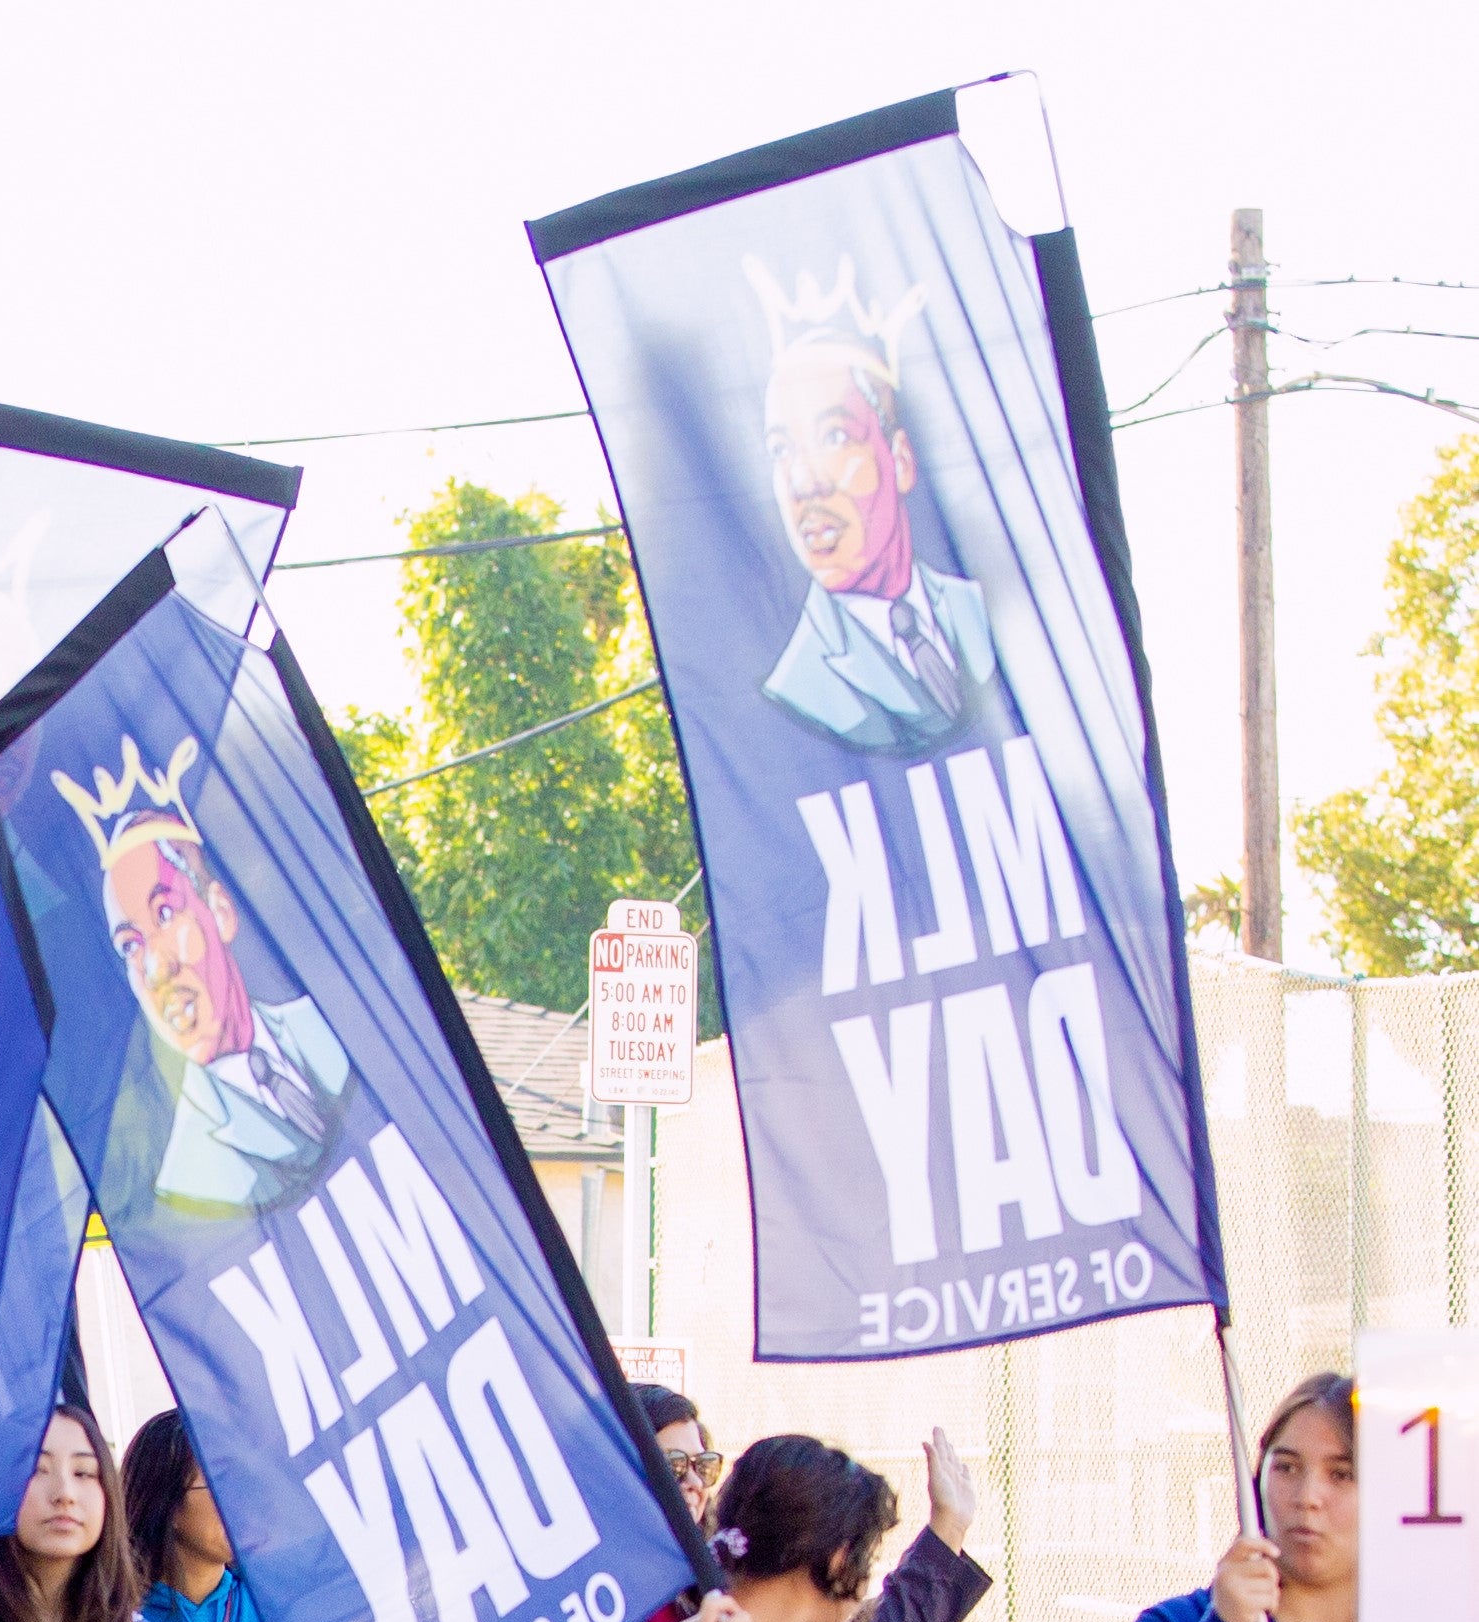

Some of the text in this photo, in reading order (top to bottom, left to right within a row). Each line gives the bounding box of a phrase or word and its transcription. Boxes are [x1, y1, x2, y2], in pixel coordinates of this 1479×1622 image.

[627, 908, 663, 929] END
[595, 938, 689, 970] NO PARKING
[601, 982, 686, 1005] 5:00 AM TO
[612, 1011, 673, 1033] 8:00 AM
[609, 1040, 675, 1062] TUESDAY
[600, 1067, 685, 1081] STREET SWEEPING
